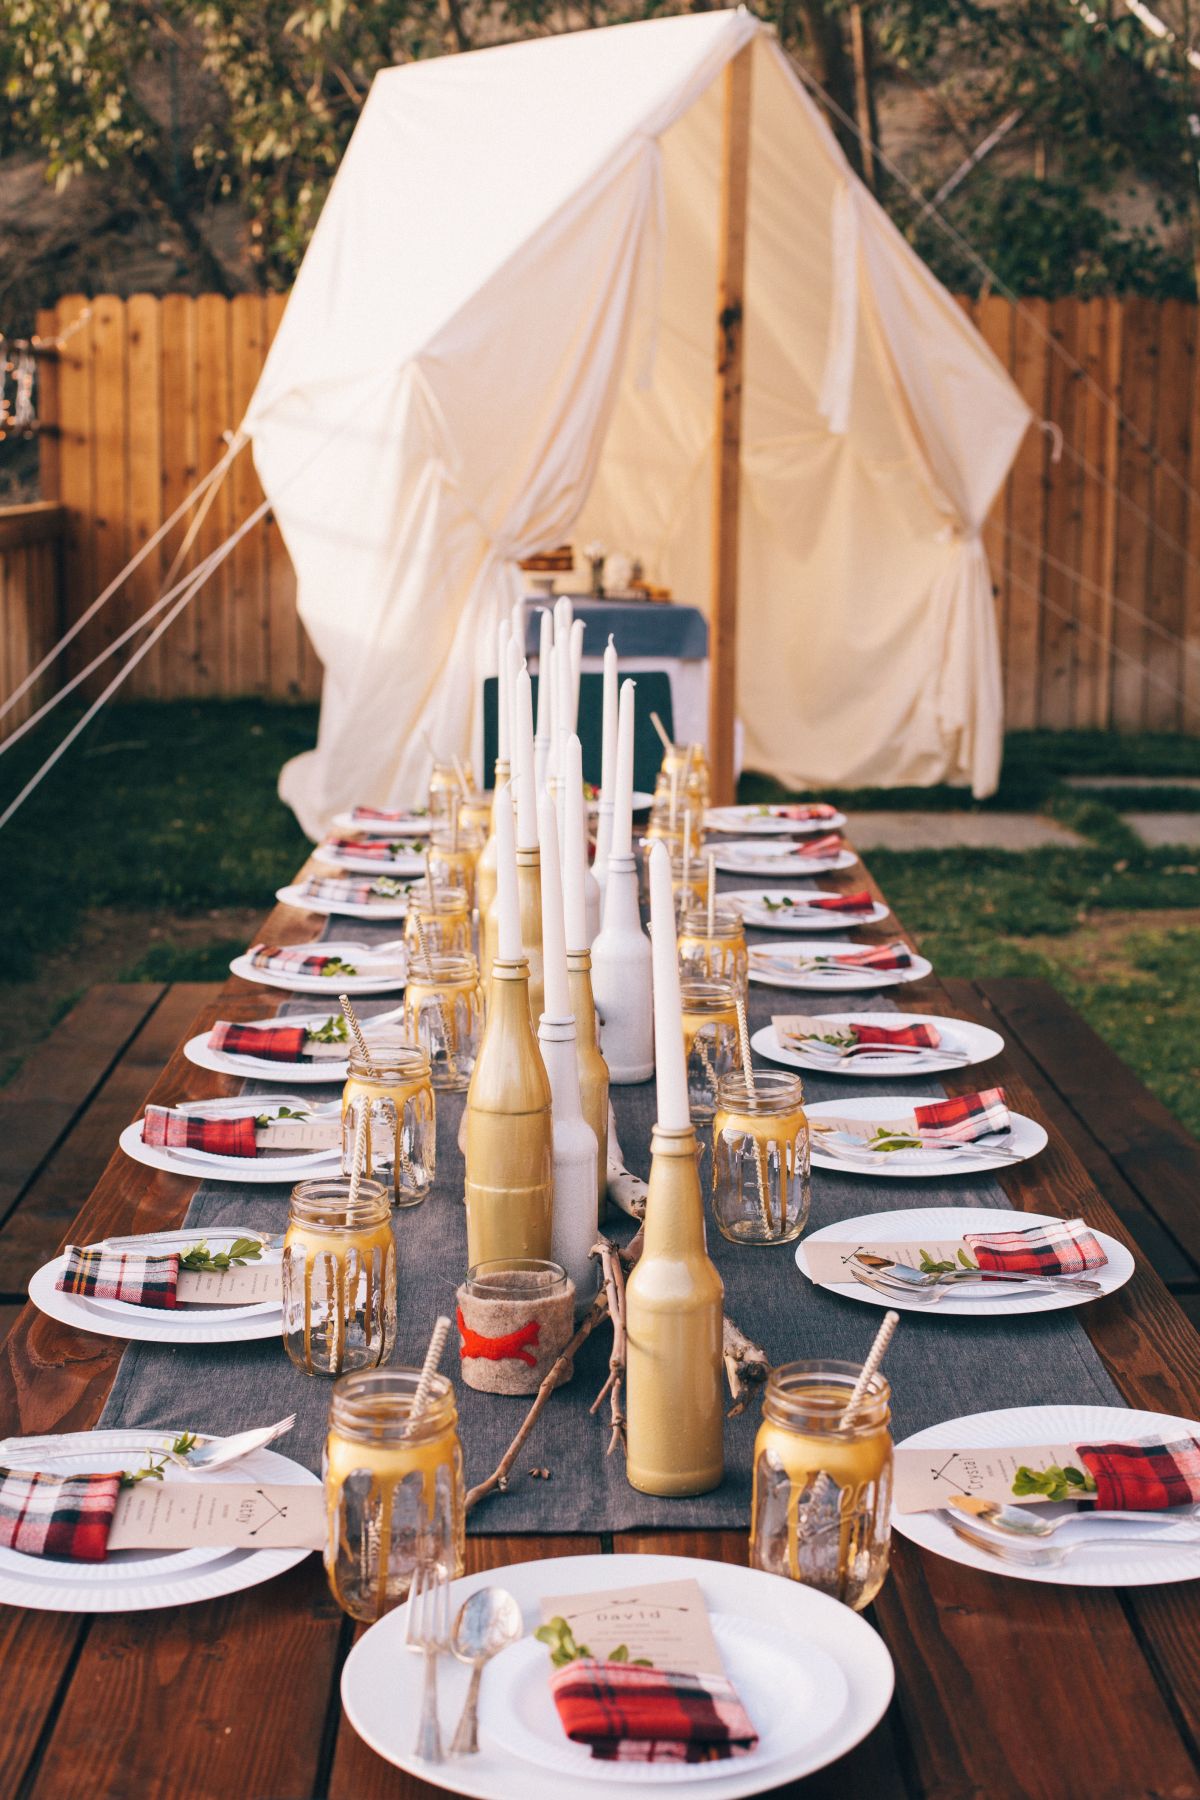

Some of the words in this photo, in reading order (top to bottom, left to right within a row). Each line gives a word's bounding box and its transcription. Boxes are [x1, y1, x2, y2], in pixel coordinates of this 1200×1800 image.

[959, 1457, 984, 1490] Crystal
[235, 1498, 256, 1523] Kathy
[596, 1610, 660, 1621] David
